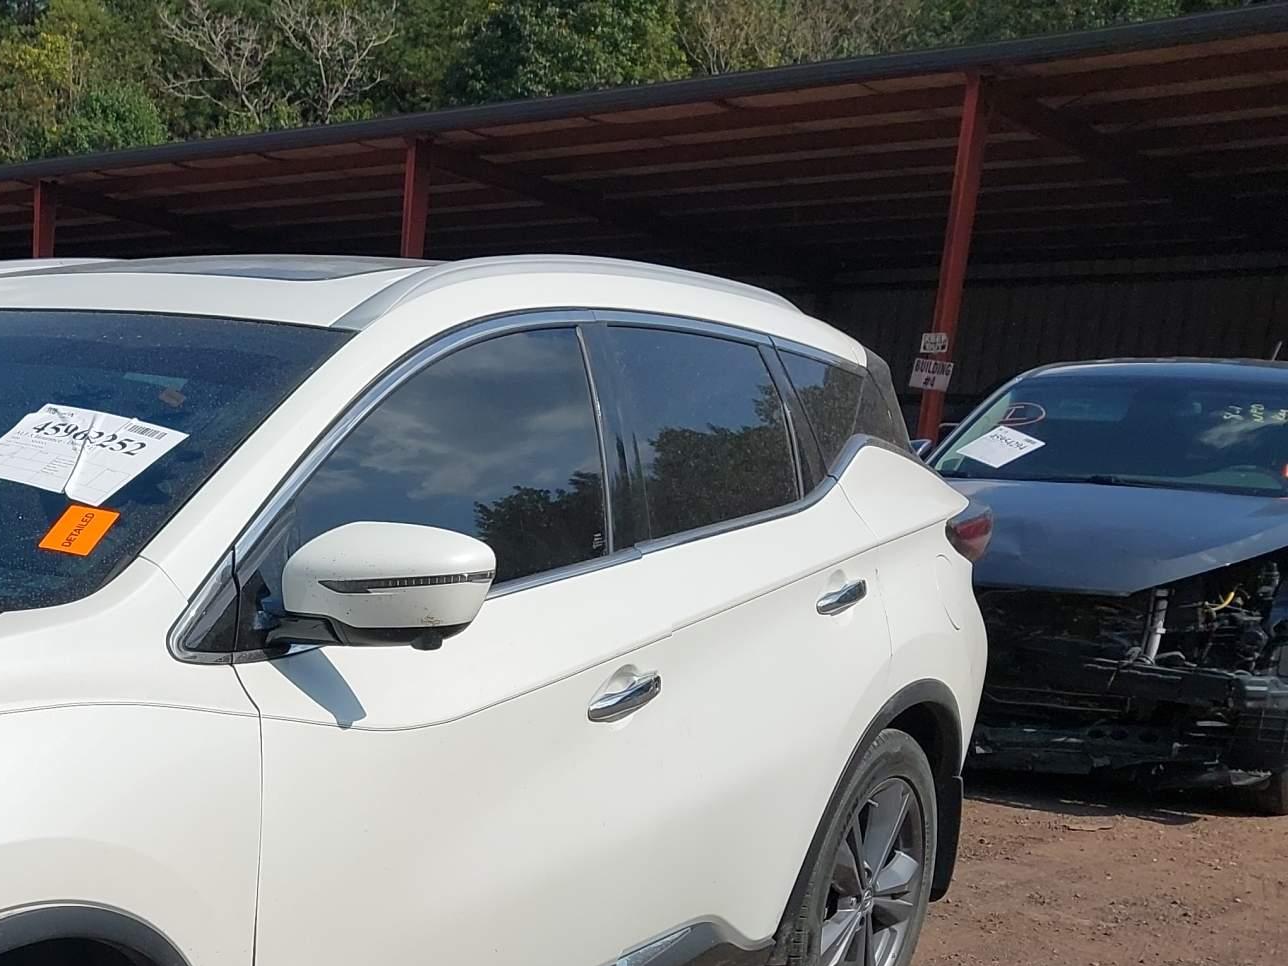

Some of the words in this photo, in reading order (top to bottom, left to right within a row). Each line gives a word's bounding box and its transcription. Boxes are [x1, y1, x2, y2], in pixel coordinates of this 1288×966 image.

[915, 359, 952, 376] BUILDING
[32, 420, 146, 456] 45962252
[61, 512, 95, 548] DETAILED
